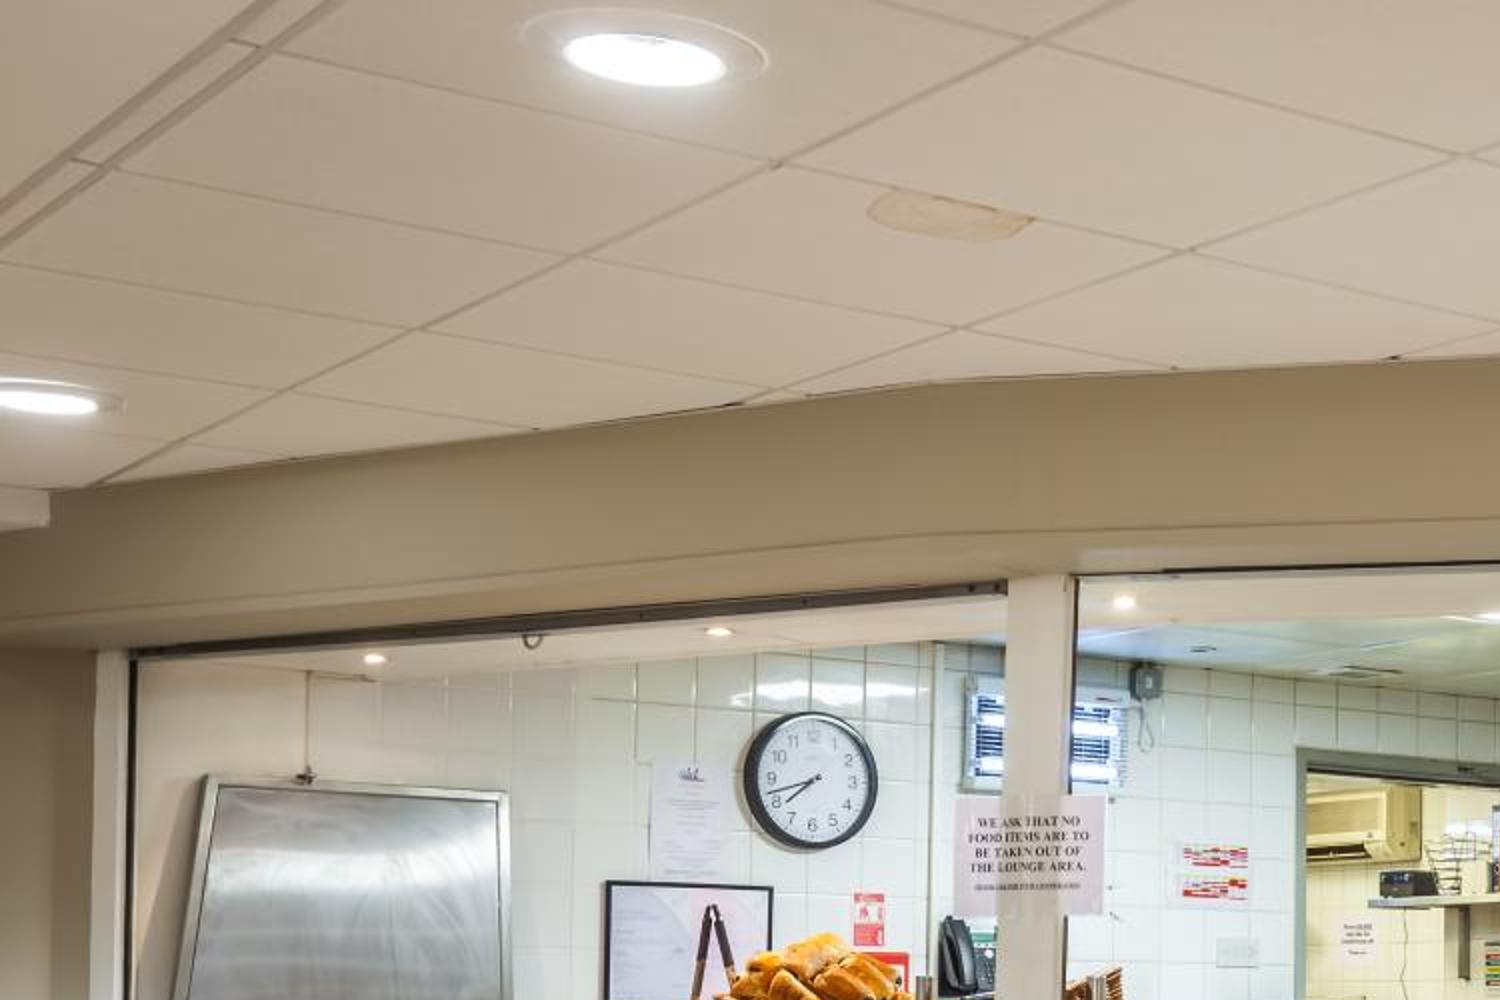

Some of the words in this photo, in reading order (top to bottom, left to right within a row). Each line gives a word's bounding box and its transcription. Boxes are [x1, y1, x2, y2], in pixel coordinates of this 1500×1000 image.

[789, 735, 799, 748] 11
[832, 737, 837, 752] 1
[773, 750, 787, 764] 10
[844, 753, 853, 767] 2
[767, 772, 777, 785] 9
[848, 776, 857, 789] 3
[772, 795, 782, 809] 8
[842, 798, 852, 810] 4
[787, 811, 796, 824] 7
[829, 813, 838, 826] 5
[977, 817, 999, 828] WE
[1002, 817, 1022, 828] ASK
[1025, 816, 1058, 827] THAT
[1062, 816, 1081, 827] NO
[808, 818, 818, 832] 6
[968, 833, 1002, 844] FOOD
[1005, 832, 1041, 843] ITEMS
[1043, 831, 1069, 842] ARE
[1072, 831, 1089, 841] TO
[975, 847, 991, 859] BE
[994, 847, 1033, 858] TAKEN
[1035, 846, 1061, 857] OUT
[1065, 846, 1082, 856] OF
[970, 862, 995, 874] THE
[998, 861, 1046, 873] LOUNGE
[1049, 861, 1087, 872] AREA.
